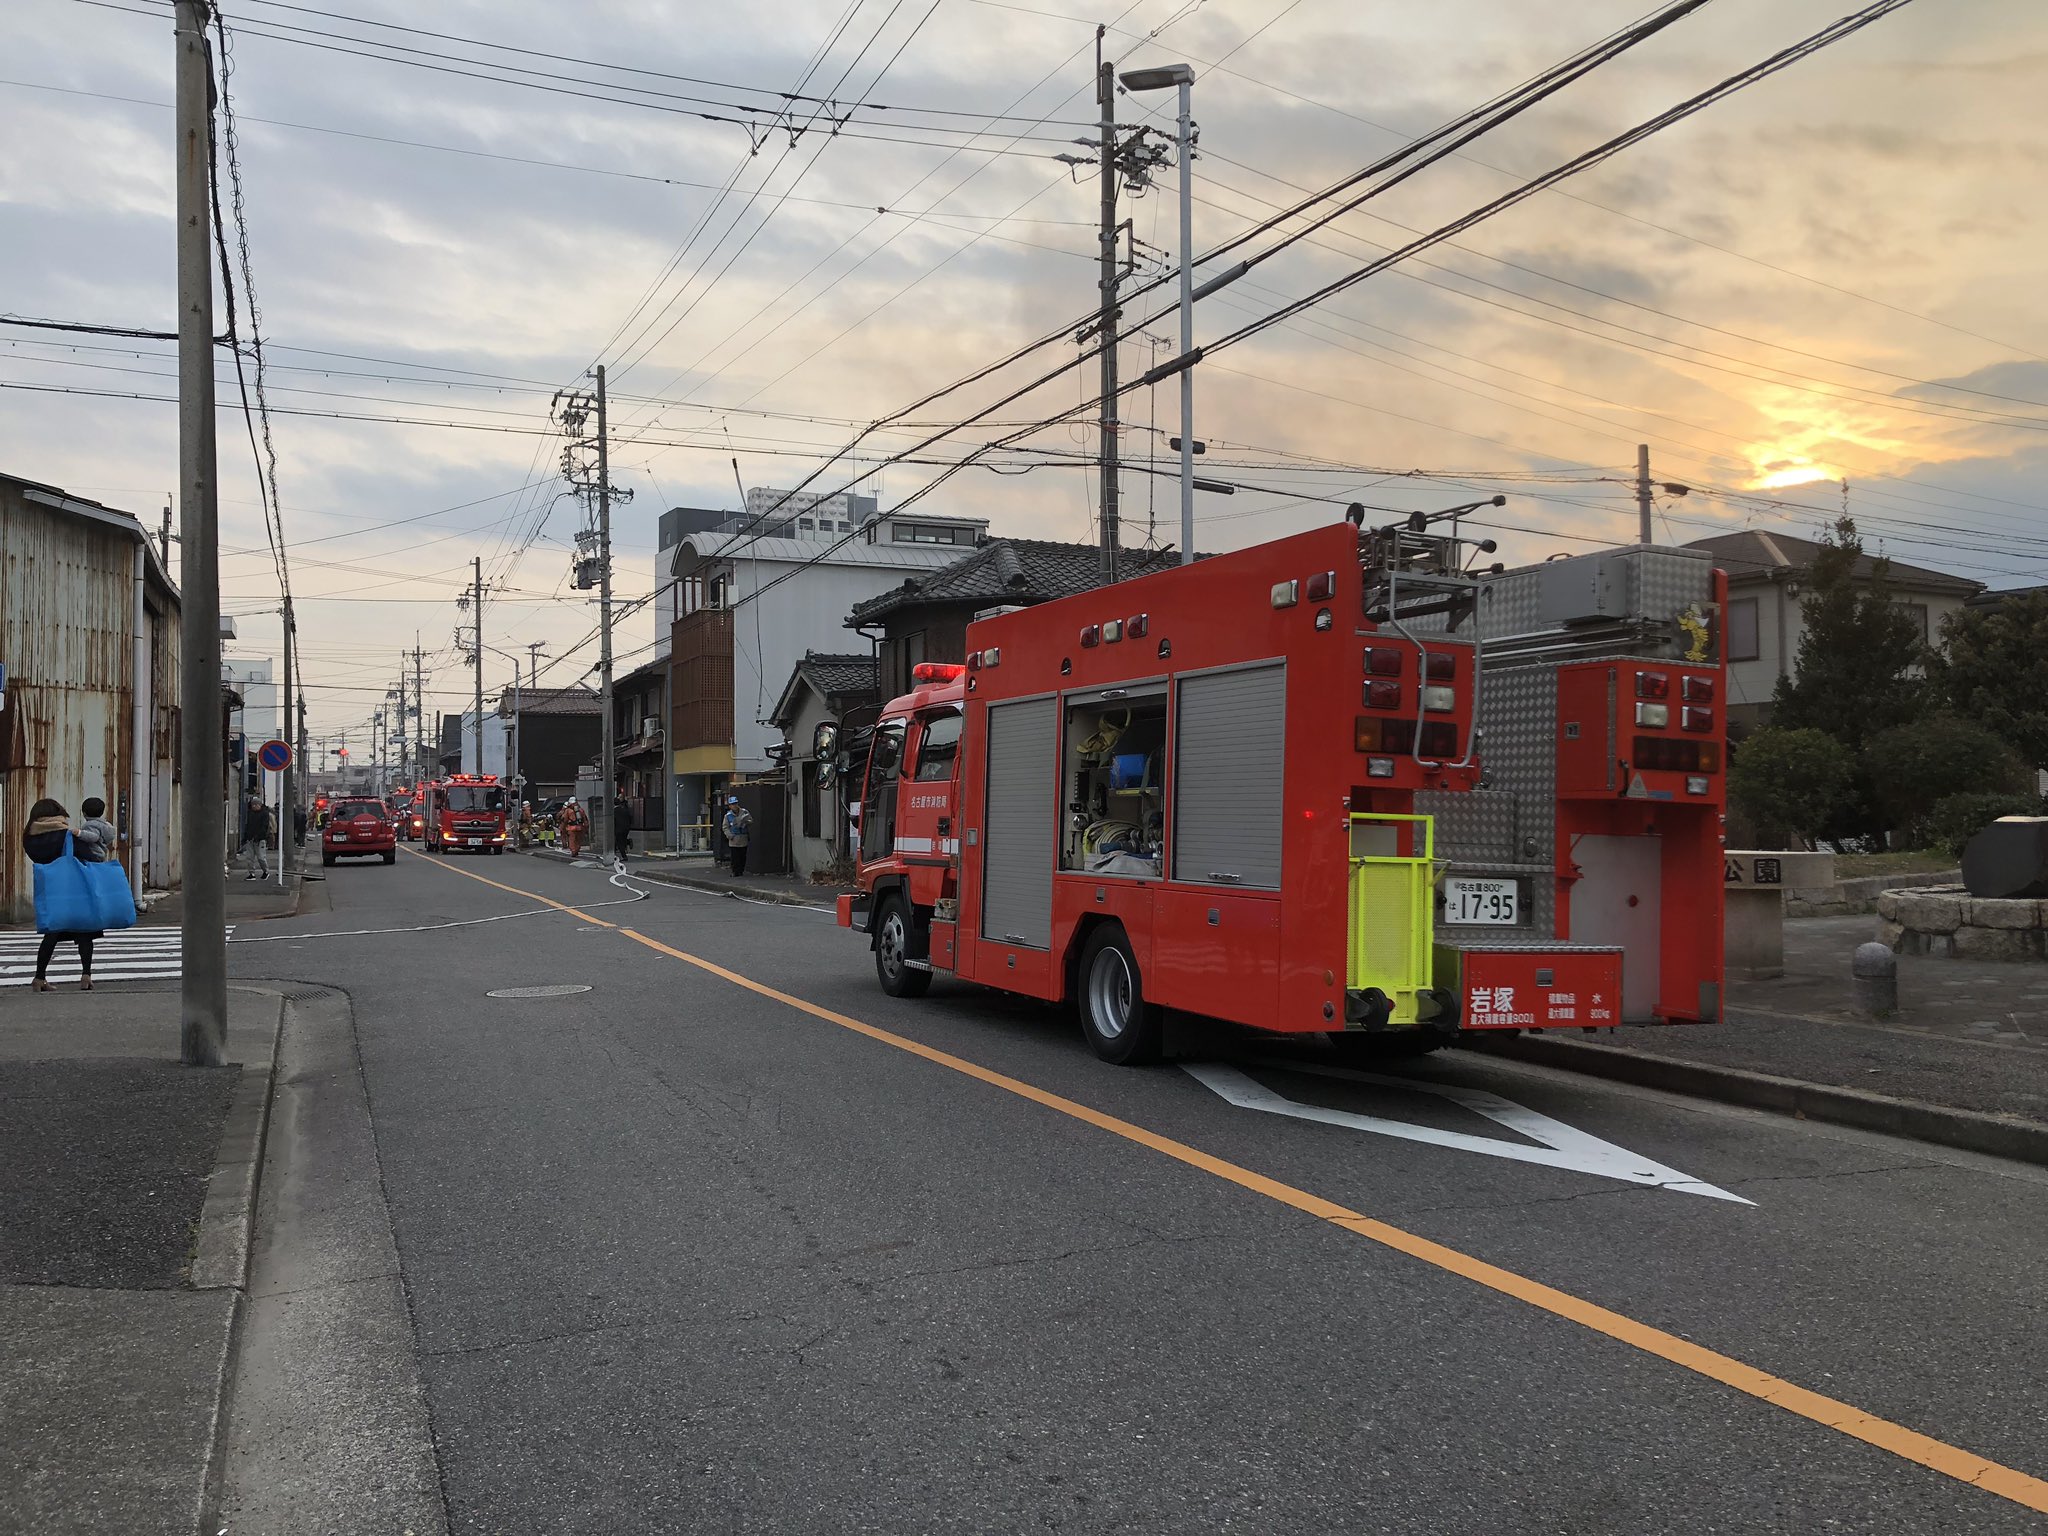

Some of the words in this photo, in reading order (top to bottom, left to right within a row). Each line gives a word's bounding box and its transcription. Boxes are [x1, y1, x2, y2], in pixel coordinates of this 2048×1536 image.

[1724, 858, 1781, 883] 公園
[1462, 894, 1513, 919] 17-95
[1470, 987, 1514, 1012] 岩塚
[1592, 993, 1601, 1004] 水
